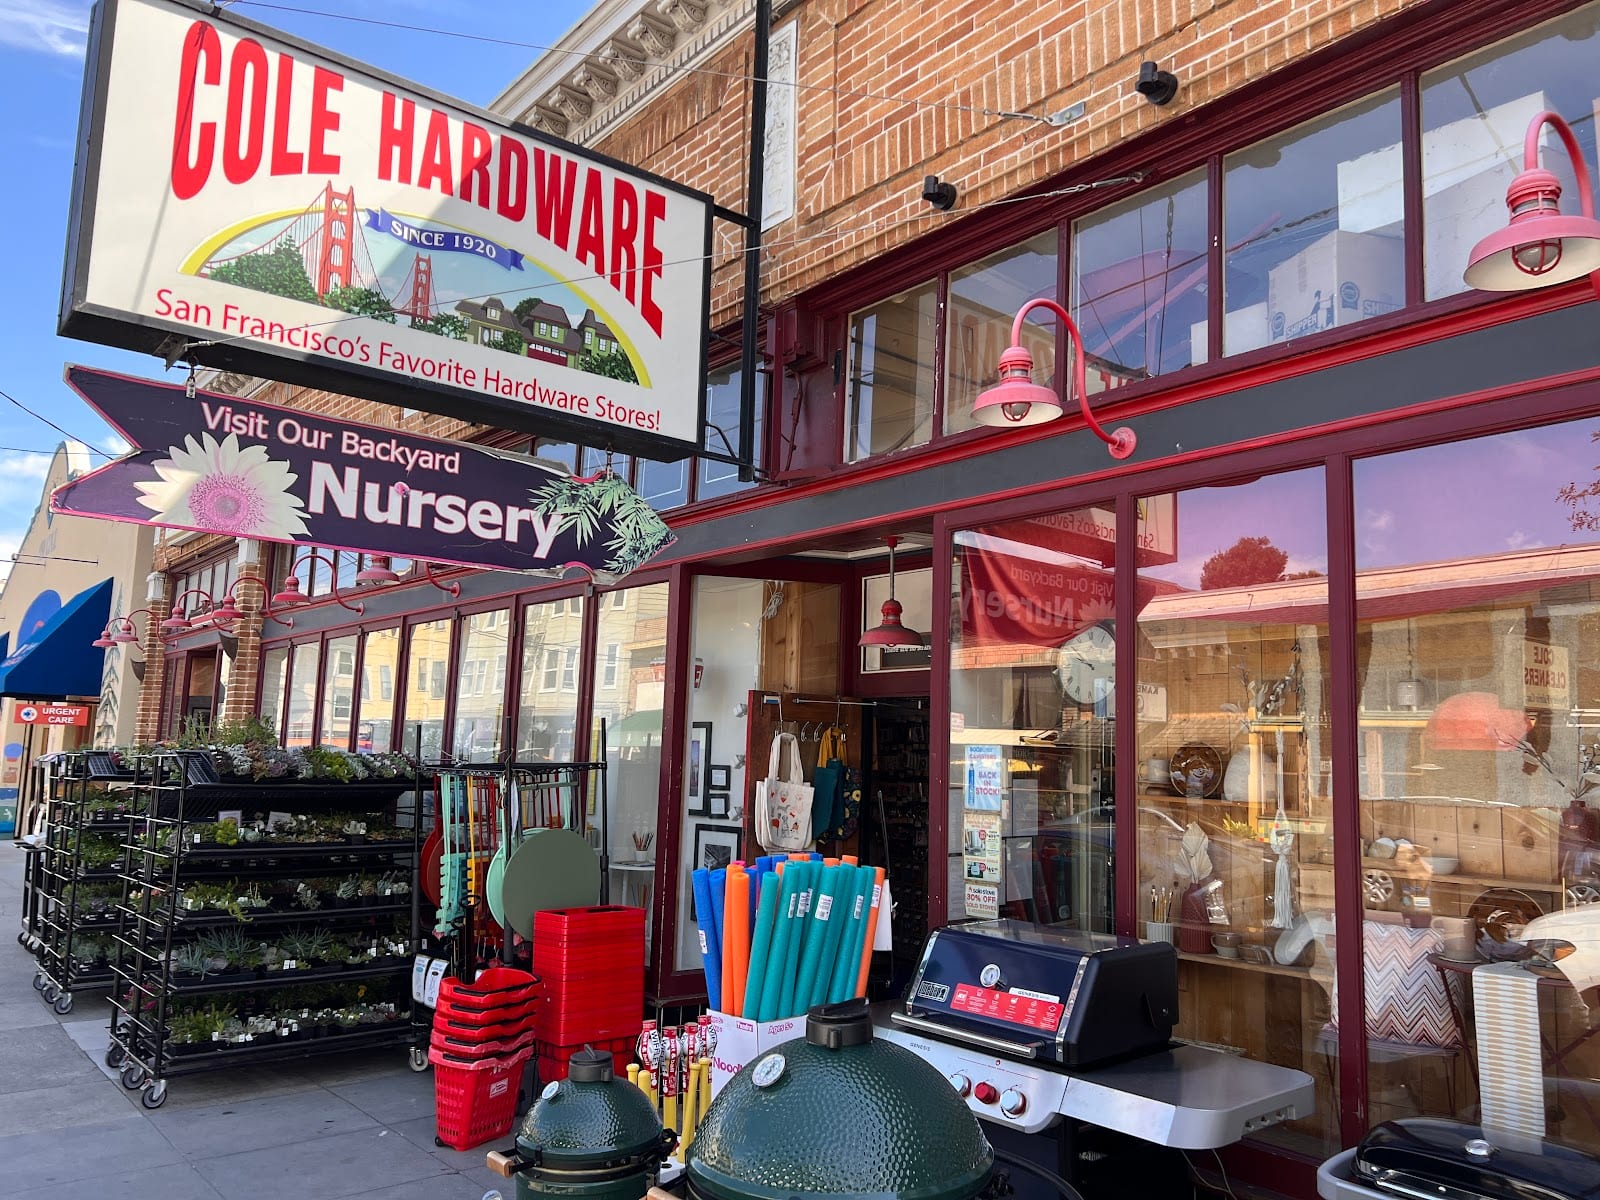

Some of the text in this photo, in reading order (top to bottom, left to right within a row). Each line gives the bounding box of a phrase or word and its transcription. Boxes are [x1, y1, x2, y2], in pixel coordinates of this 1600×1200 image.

[171, 20, 666, 340] COLE HARDWARE
[390, 219, 496, 259] SINCE 1920
[155, 288, 661, 432] San Francisco's Favorite Hardware Stores!
[201, 402, 461, 475] Visit Our Backyard
[308, 459, 564, 559] Nursery
[42, 707, 81, 717] URGENT
[47, 716, 75, 724] CARE
[978, 771, 997, 779] BACK
[966, 893, 996, 904] 30% OFF
[768, 1024, 784, 1035] Ages
[713, 1057, 743, 1074] Noodl
